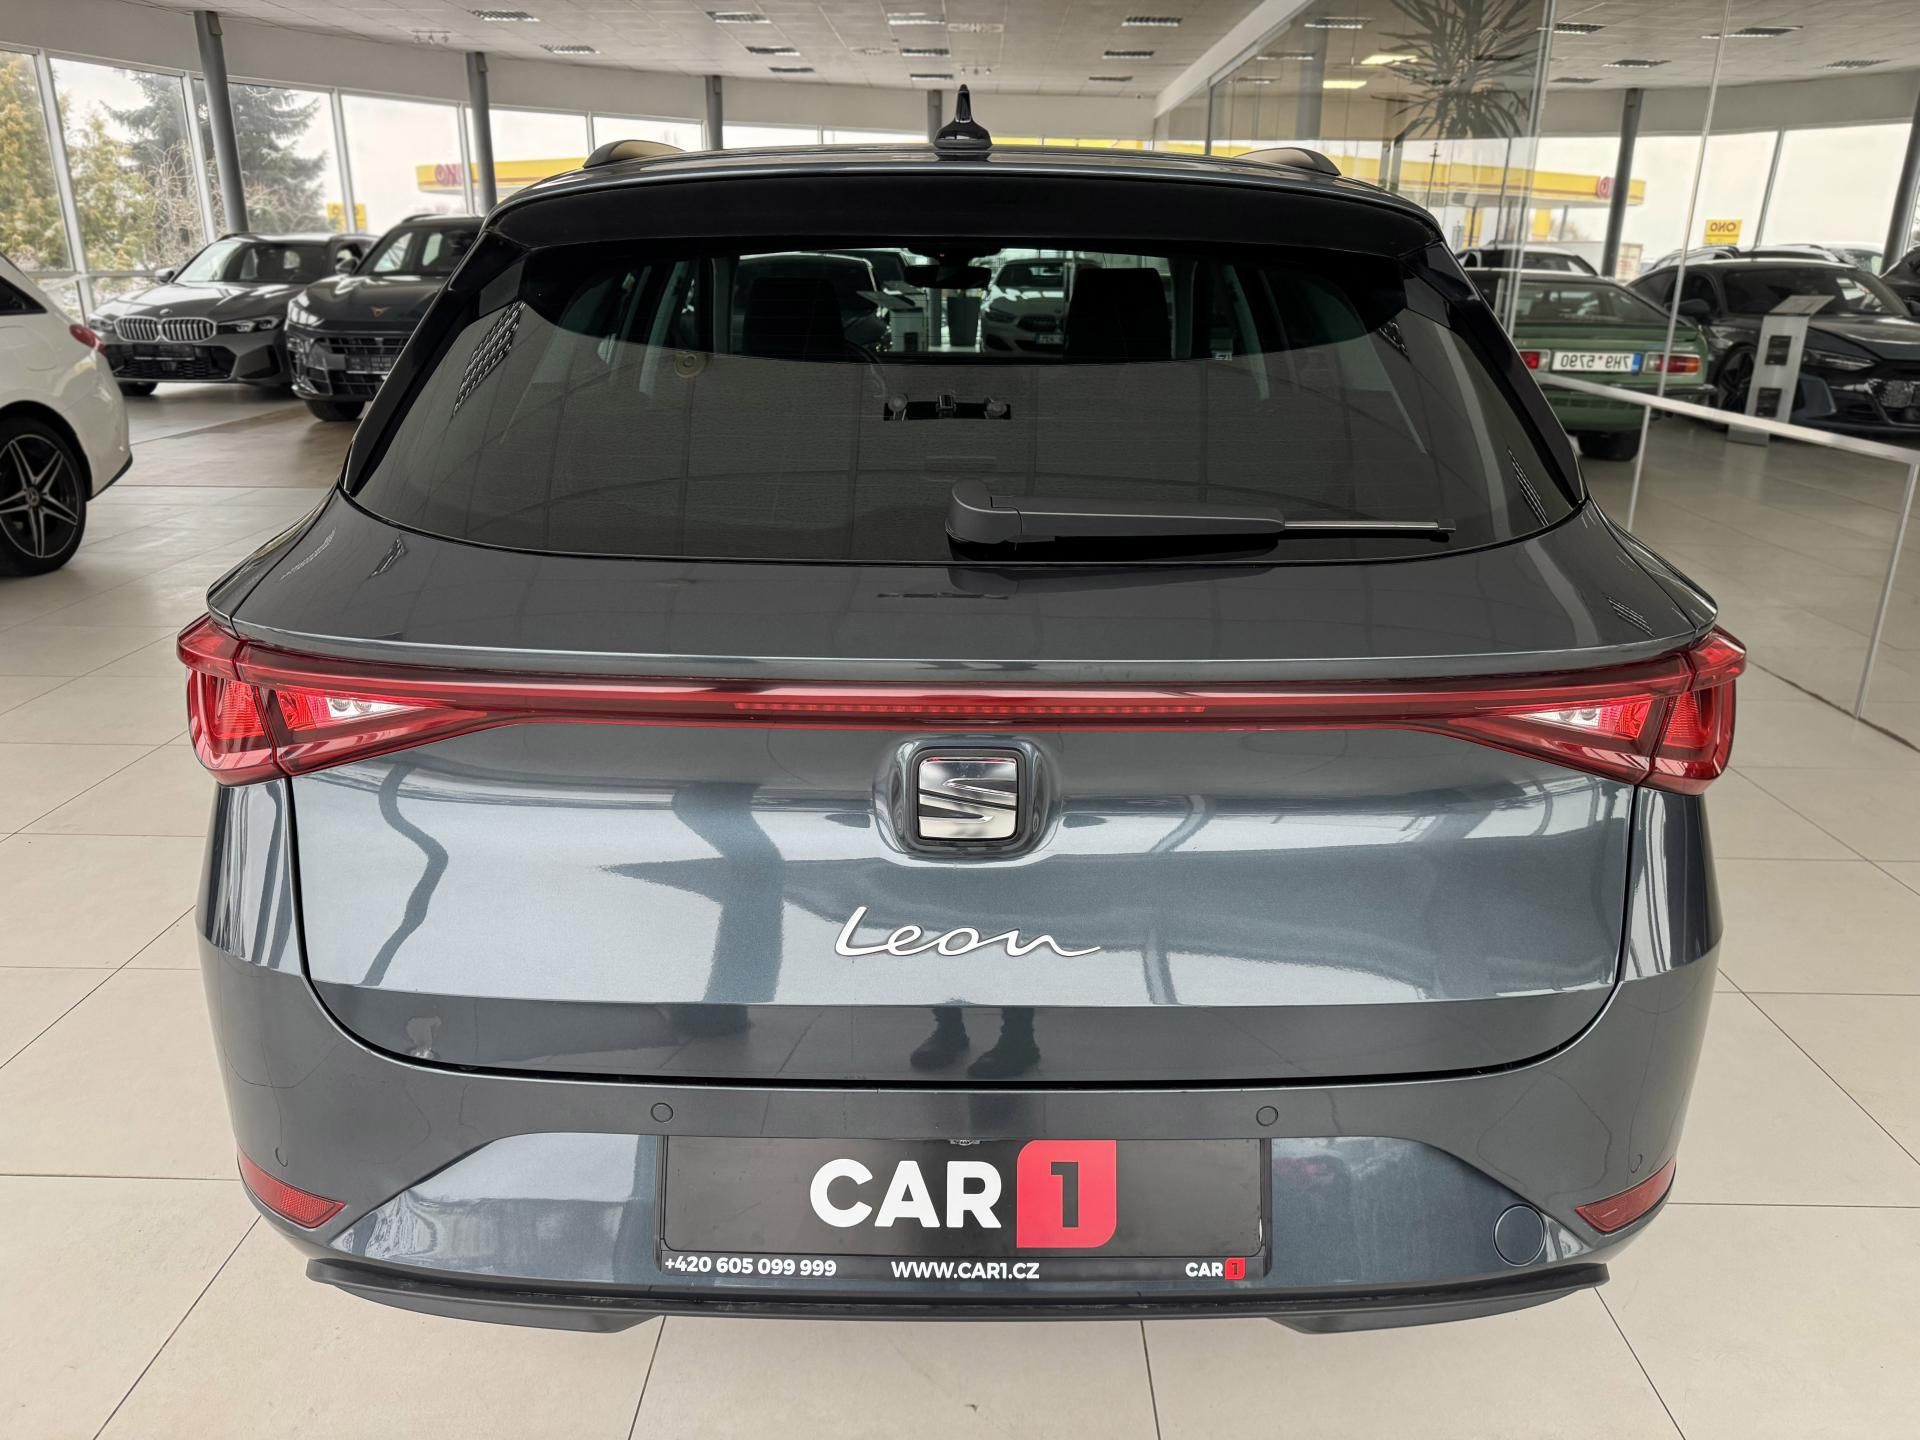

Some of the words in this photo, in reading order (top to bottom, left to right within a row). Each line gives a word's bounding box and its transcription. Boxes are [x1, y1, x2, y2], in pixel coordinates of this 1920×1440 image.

[835, 906, 1101, 957] Leon
[809, 1158, 1002, 1228] CAR
[664, 1255, 712, 1273] +420
[716, 1257, 753, 1274] 605
[757, 1258, 796, 1275] 099
[799, 1259, 837, 1277] 999
[890, 1261, 1040, 1280] WWW.CAR1.CZ
[1185, 1262, 1224, 1277] CAR
